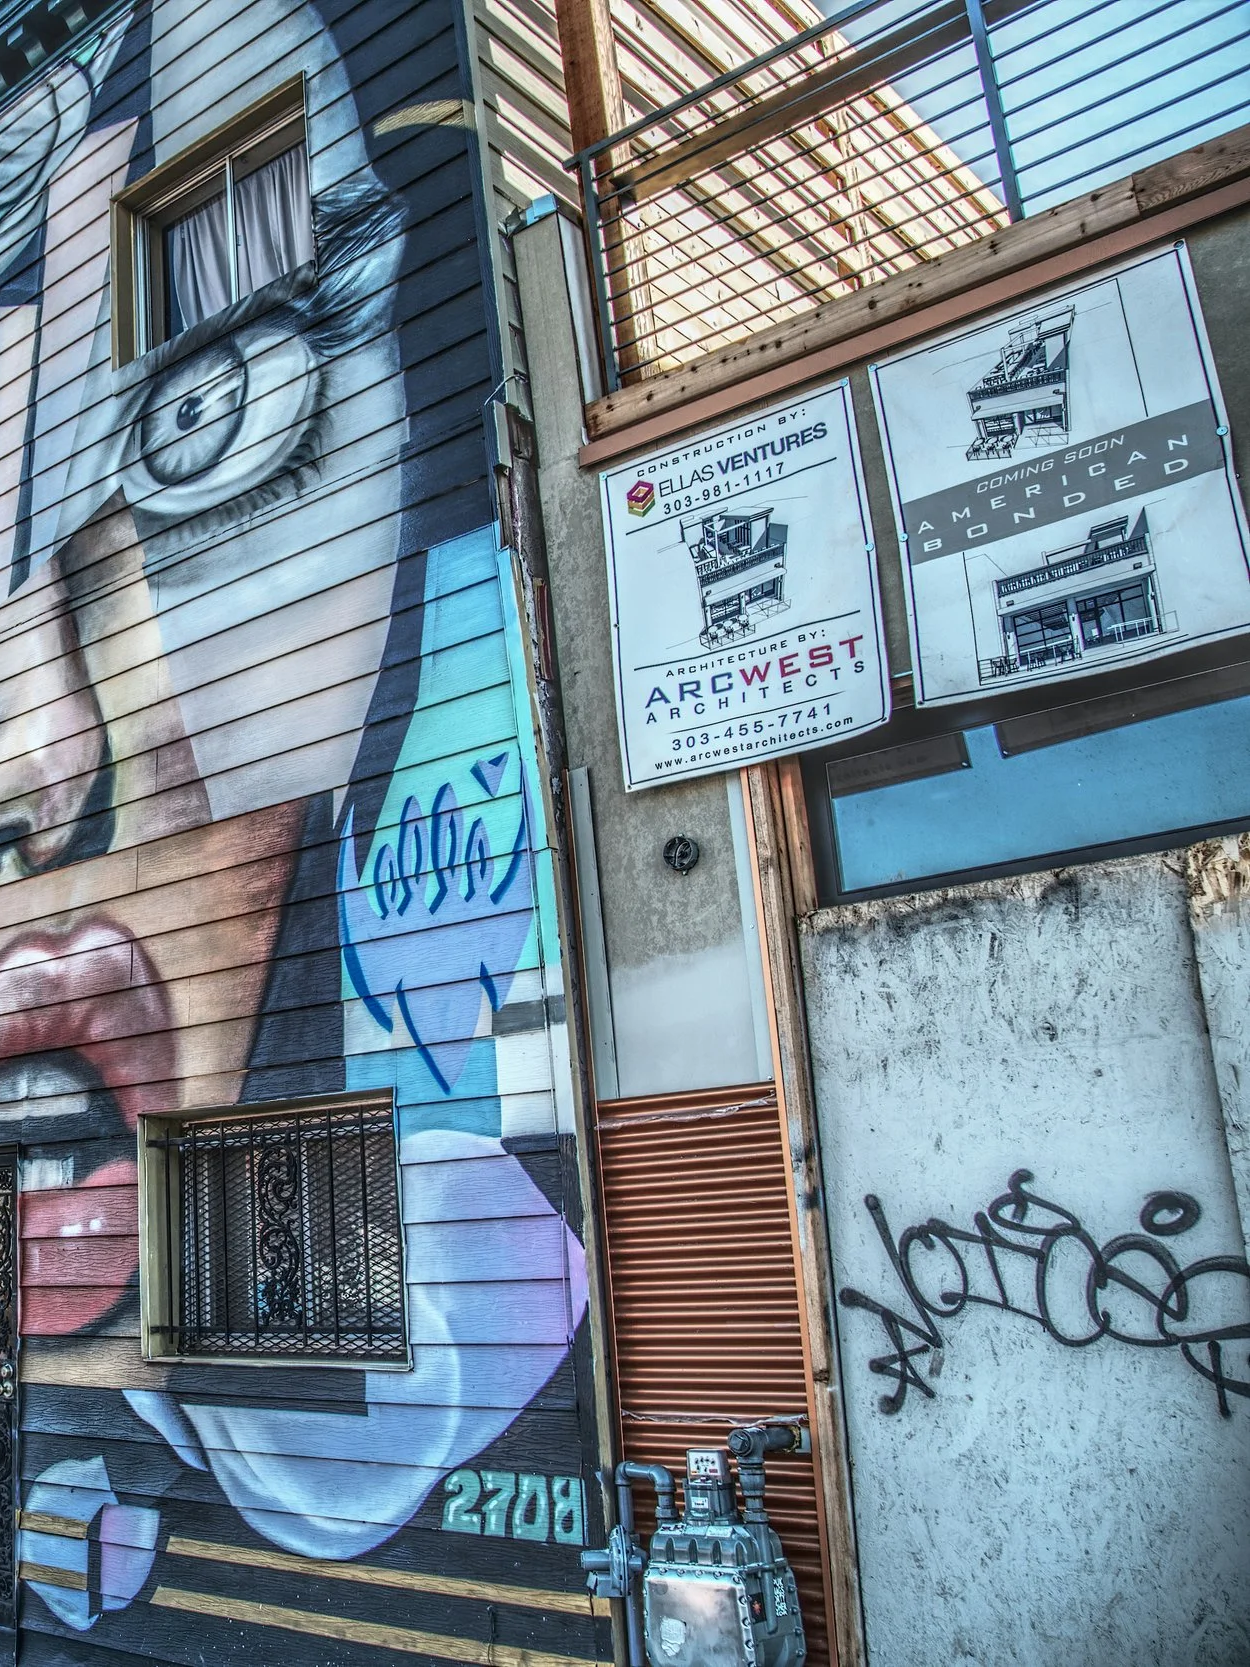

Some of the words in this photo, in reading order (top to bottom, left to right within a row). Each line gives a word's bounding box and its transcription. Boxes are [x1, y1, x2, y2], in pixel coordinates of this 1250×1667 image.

[637, 424, 766, 477] CONSTRUCTION
[778, 408, 807, 425] BY:
[659, 464, 715, 497] ELLAS
[716, 421, 828, 475] VENTURES
[976, 459, 1054, 494] COMING
[1064, 434, 1125, 464] SOON
[663, 462, 785, 515] 303-981-1117
[918, 434, 1188, 534] AMERICAN
[923, 458, 1189, 553] BONDED
[645, 635, 864, 709] ARCWEST
[666, 640, 788, 677] ARCHITECTURE
[798, 629, 826, 642] BY:
[645, 661, 865, 725] ARCHITECTS
[655, 715, 853, 770] www.arcwestarchitects.com
[672, 703, 831, 751] 303-455-7741
[441, 1468, 588, 1546] 2708
